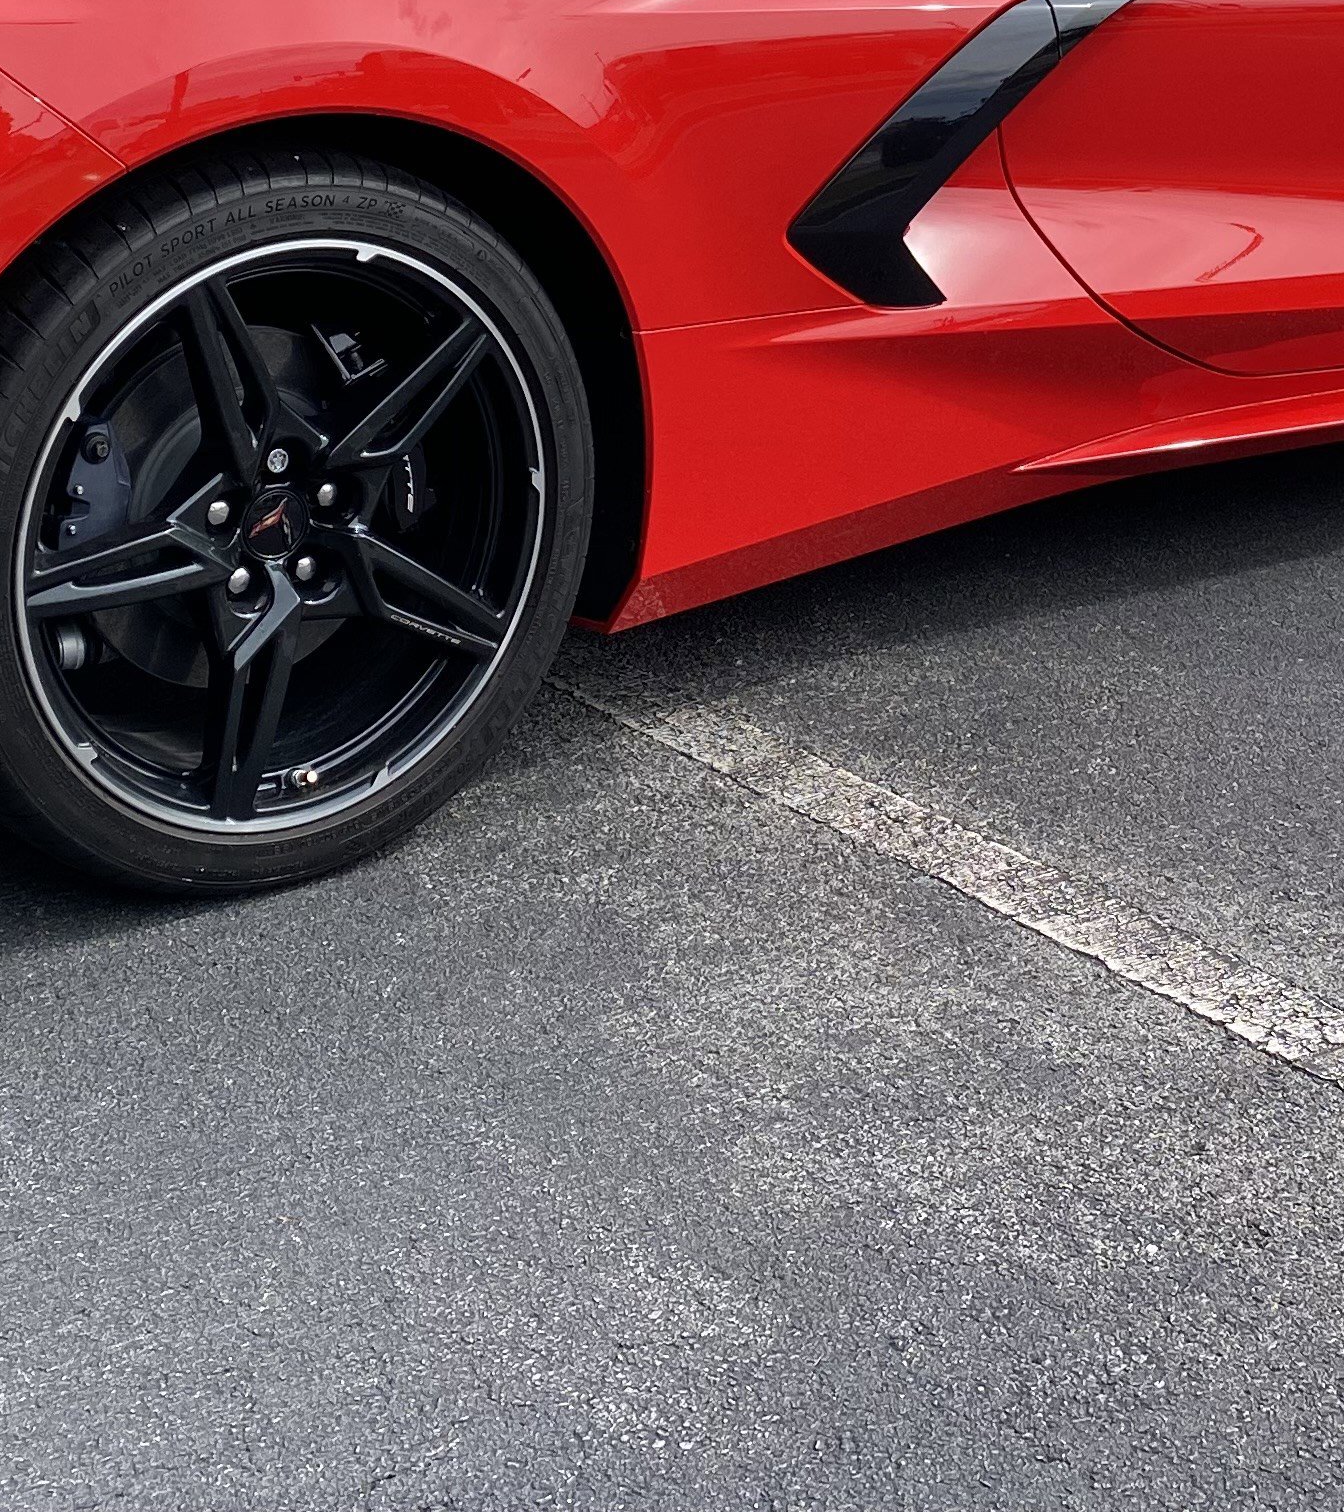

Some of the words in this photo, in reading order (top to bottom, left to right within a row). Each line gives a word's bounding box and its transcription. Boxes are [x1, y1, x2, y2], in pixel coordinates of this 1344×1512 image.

[109, 252, 154, 298] PILOT
[160, 217, 218, 259] SPORT
[224, 204, 257, 227] ALL
[264, 193, 337, 214] SEASON
[342, 195, 351, 204] 4
[356, 196, 378, 210] ZP
[391, 614, 461, 645] CORVETTE
